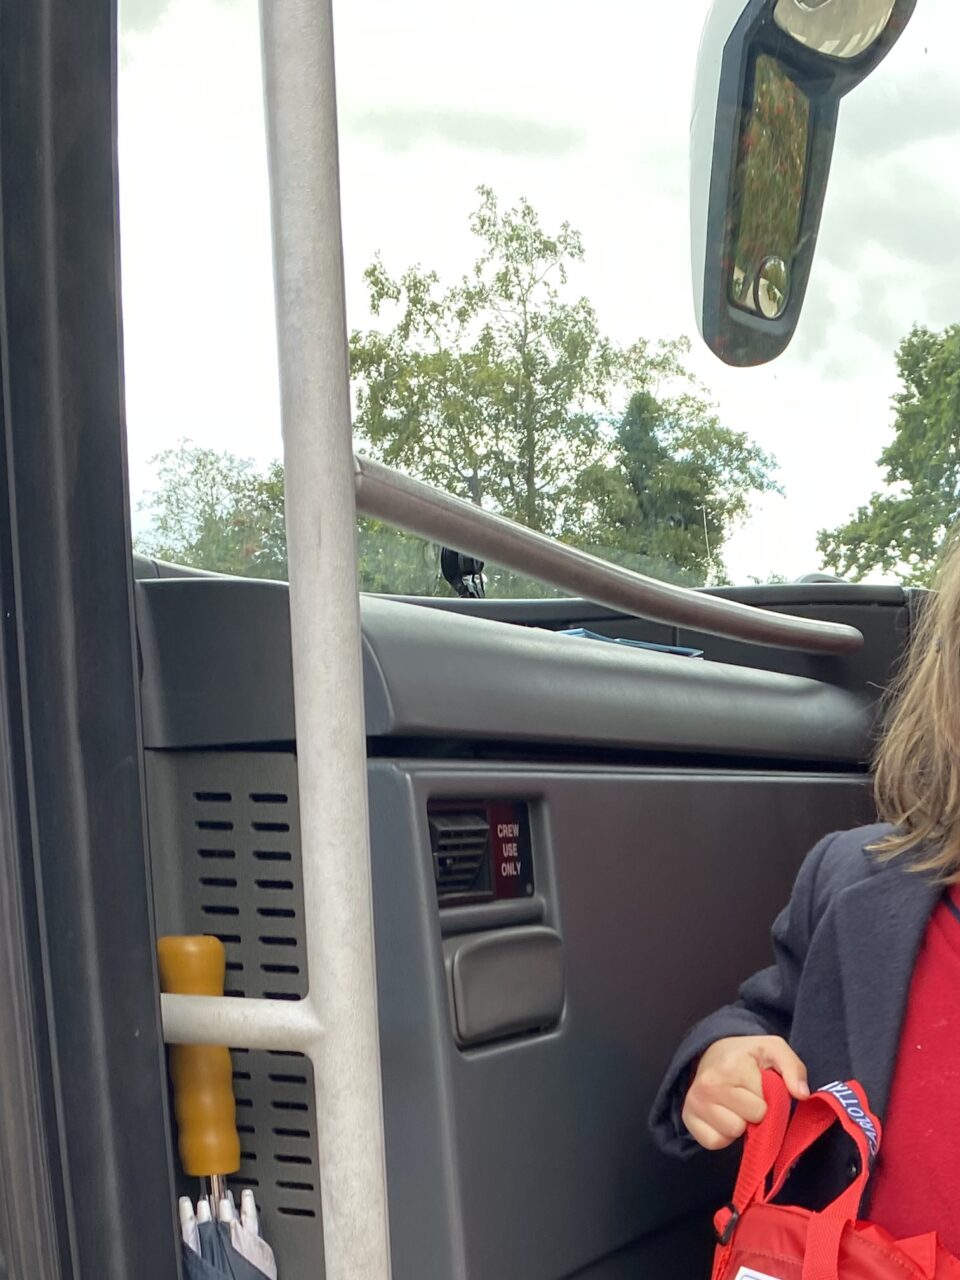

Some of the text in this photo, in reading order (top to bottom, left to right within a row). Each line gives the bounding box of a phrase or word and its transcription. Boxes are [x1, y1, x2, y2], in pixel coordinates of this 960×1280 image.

[497, 824, 519, 838] CREW
[502, 843, 518, 857] USE
[501, 861, 521, 877] ONLY
[827, 1082, 878, 1157] CARLOTTA
